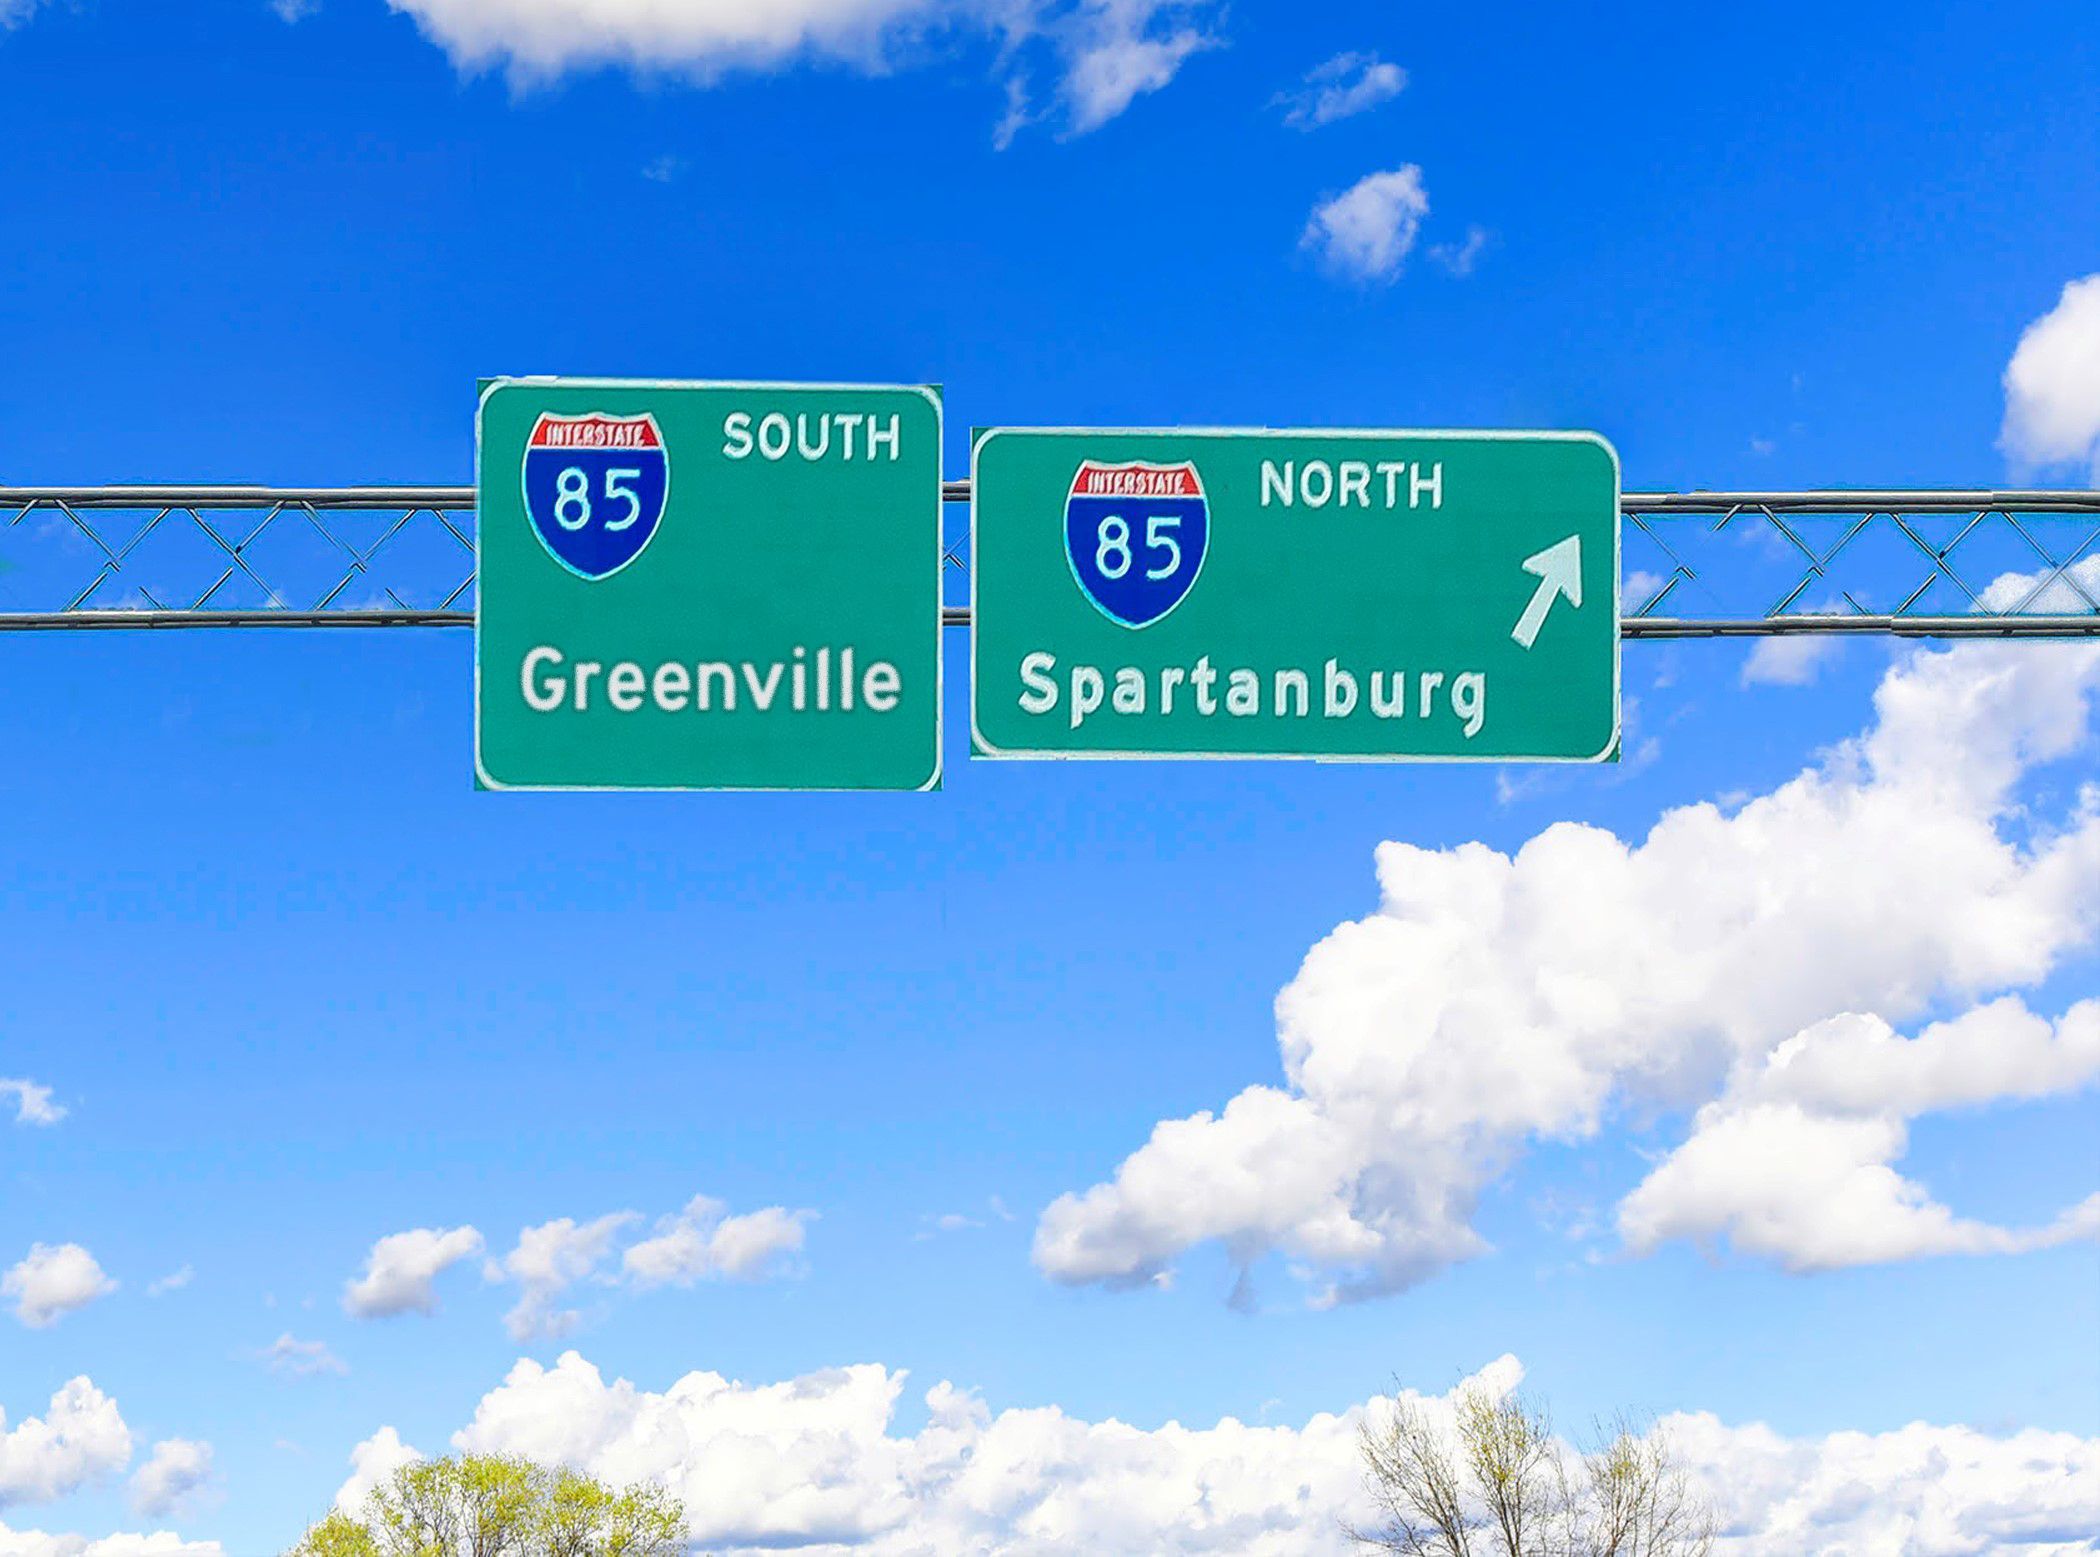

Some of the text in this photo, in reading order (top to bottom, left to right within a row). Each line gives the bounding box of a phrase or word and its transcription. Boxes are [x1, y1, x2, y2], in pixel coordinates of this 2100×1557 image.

[546, 424, 646, 446] INTERSTATE
[722, 411, 899, 461] SOUTH
[554, 467, 641, 531] 85
[1087, 472, 1186, 494] INTERSTATE
[1260, 461, 1442, 509] NORTH
[1096, 515, 1182, 580] 85
[520, 645, 901, 712] Greenville
[1018, 651, 1486, 738] Spartanburg
